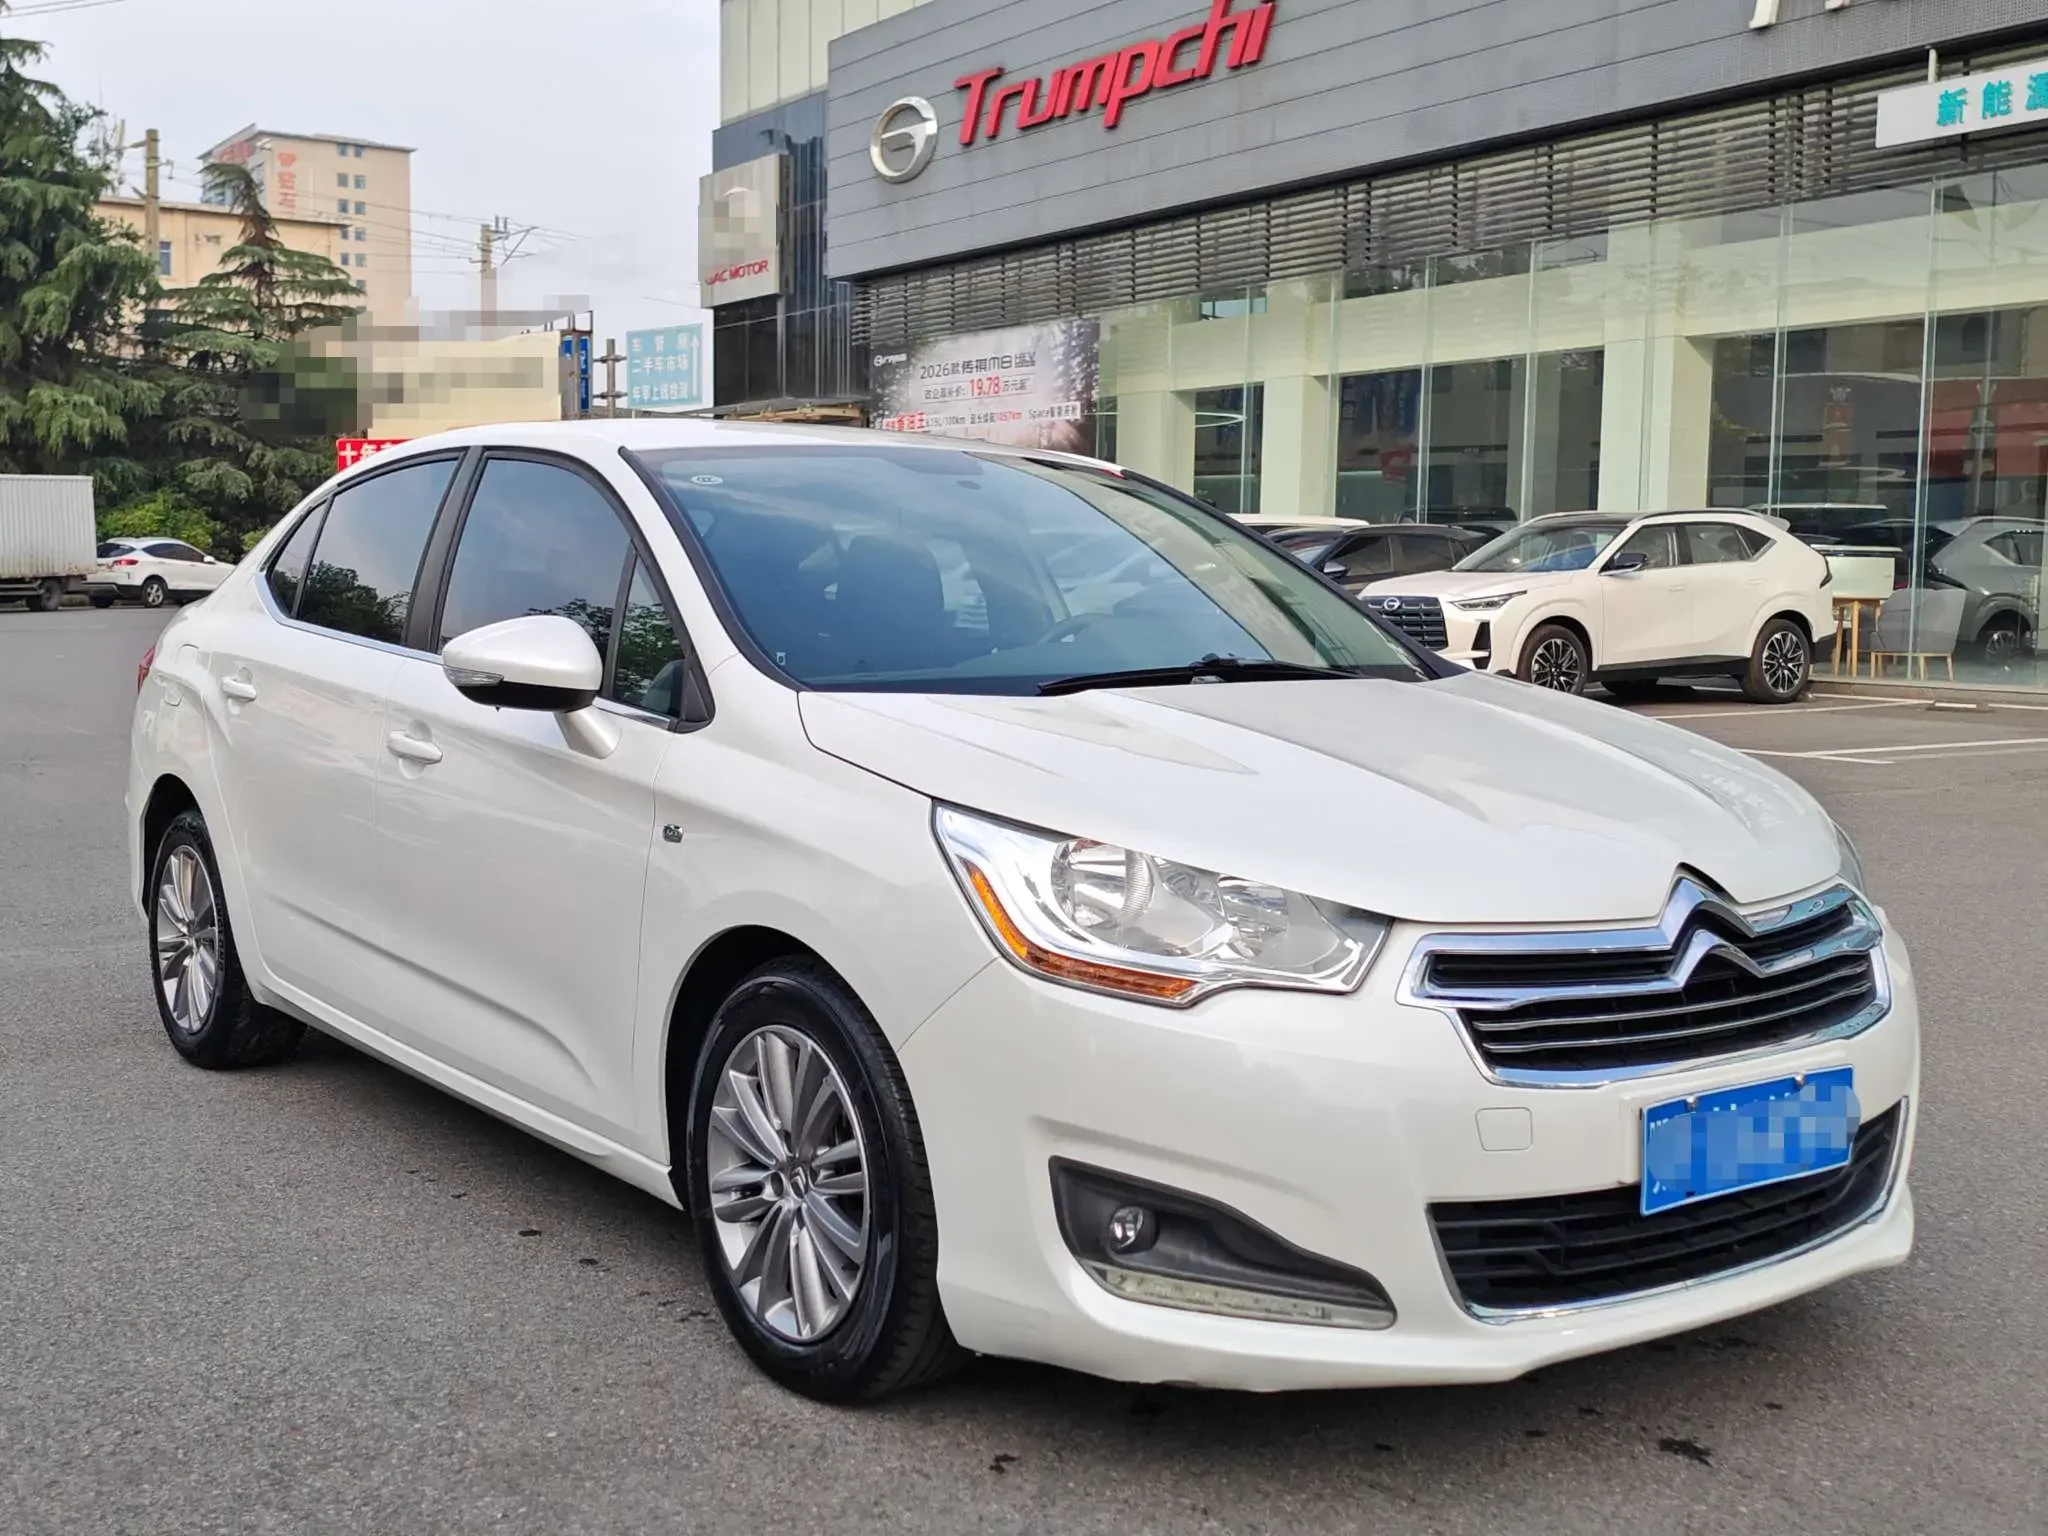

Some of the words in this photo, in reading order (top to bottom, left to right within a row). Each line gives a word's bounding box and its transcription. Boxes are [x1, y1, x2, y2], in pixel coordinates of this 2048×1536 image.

[954, 0, 1277, 146] Trumpchi
[1936, 71, 2048, 127] 新能源
[729, 259, 769, 280] MOTOR
[631, 353, 688, 374] 二手车市场
[969, 376, 1000, 397] 19.78
[339, 442, 395, 467] 十年
